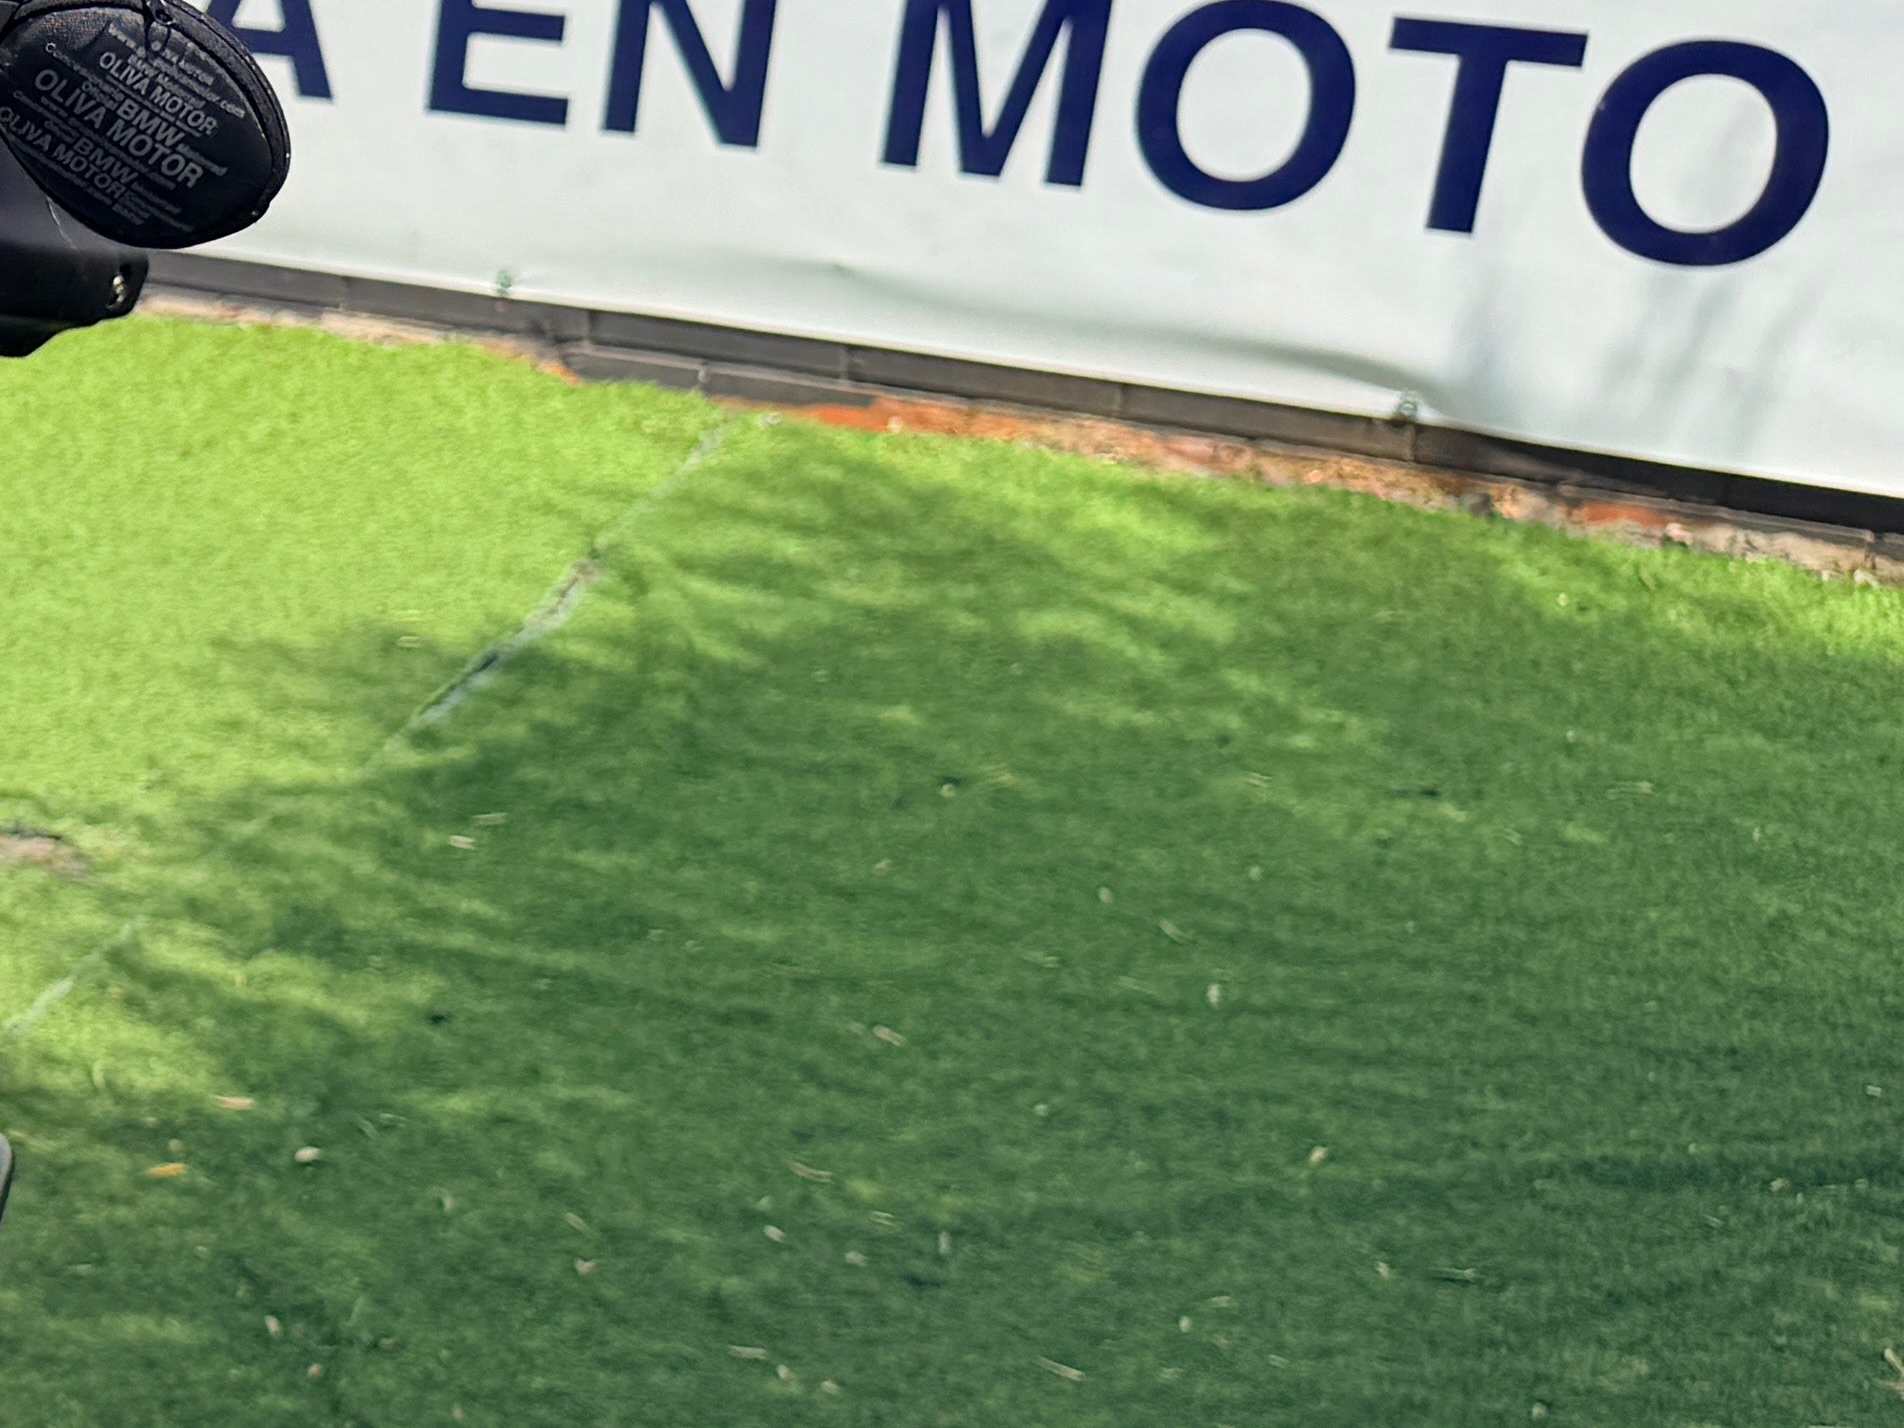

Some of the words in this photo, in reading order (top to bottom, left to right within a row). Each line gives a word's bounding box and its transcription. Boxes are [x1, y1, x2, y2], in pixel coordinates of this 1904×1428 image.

[97, 51, 152, 94] OLIVA
[151, 86, 217, 136] MOTOR
[33, 66, 109, 128] OLIVA
[107, 116, 204, 190] MOTOR
[117, 98, 183, 150] BMW
[53, 144, 127, 200] MOTOR
[74, 137, 138, 186] BMW
